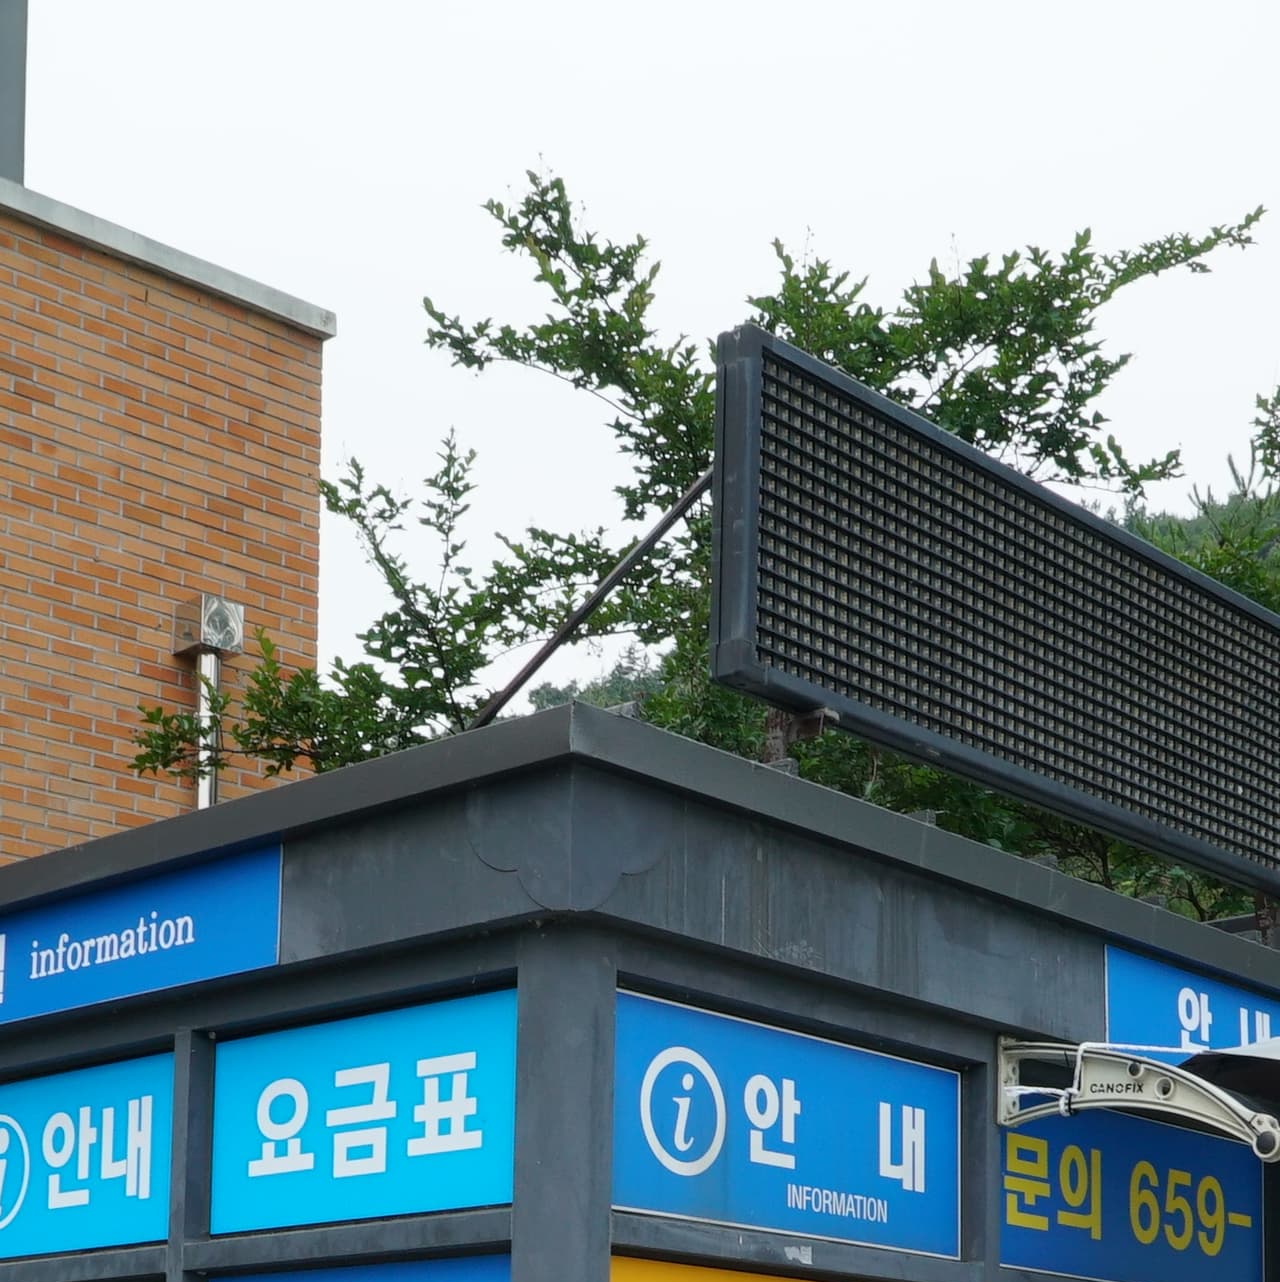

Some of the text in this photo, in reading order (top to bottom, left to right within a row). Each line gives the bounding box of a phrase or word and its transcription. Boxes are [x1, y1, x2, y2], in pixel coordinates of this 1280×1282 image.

[30, 911, 195, 980] information
[248, 1052, 483, 1179] 요금표
[1090, 1083, 1143, 1093] CANOFIX
[42, 1095, 153, 1210] 안내
[1004, 1131, 1102, 1240] 문의
[1129, 1161, 1252, 1258] 659-
[787, 1183, 887, 1223] INFORMATION
